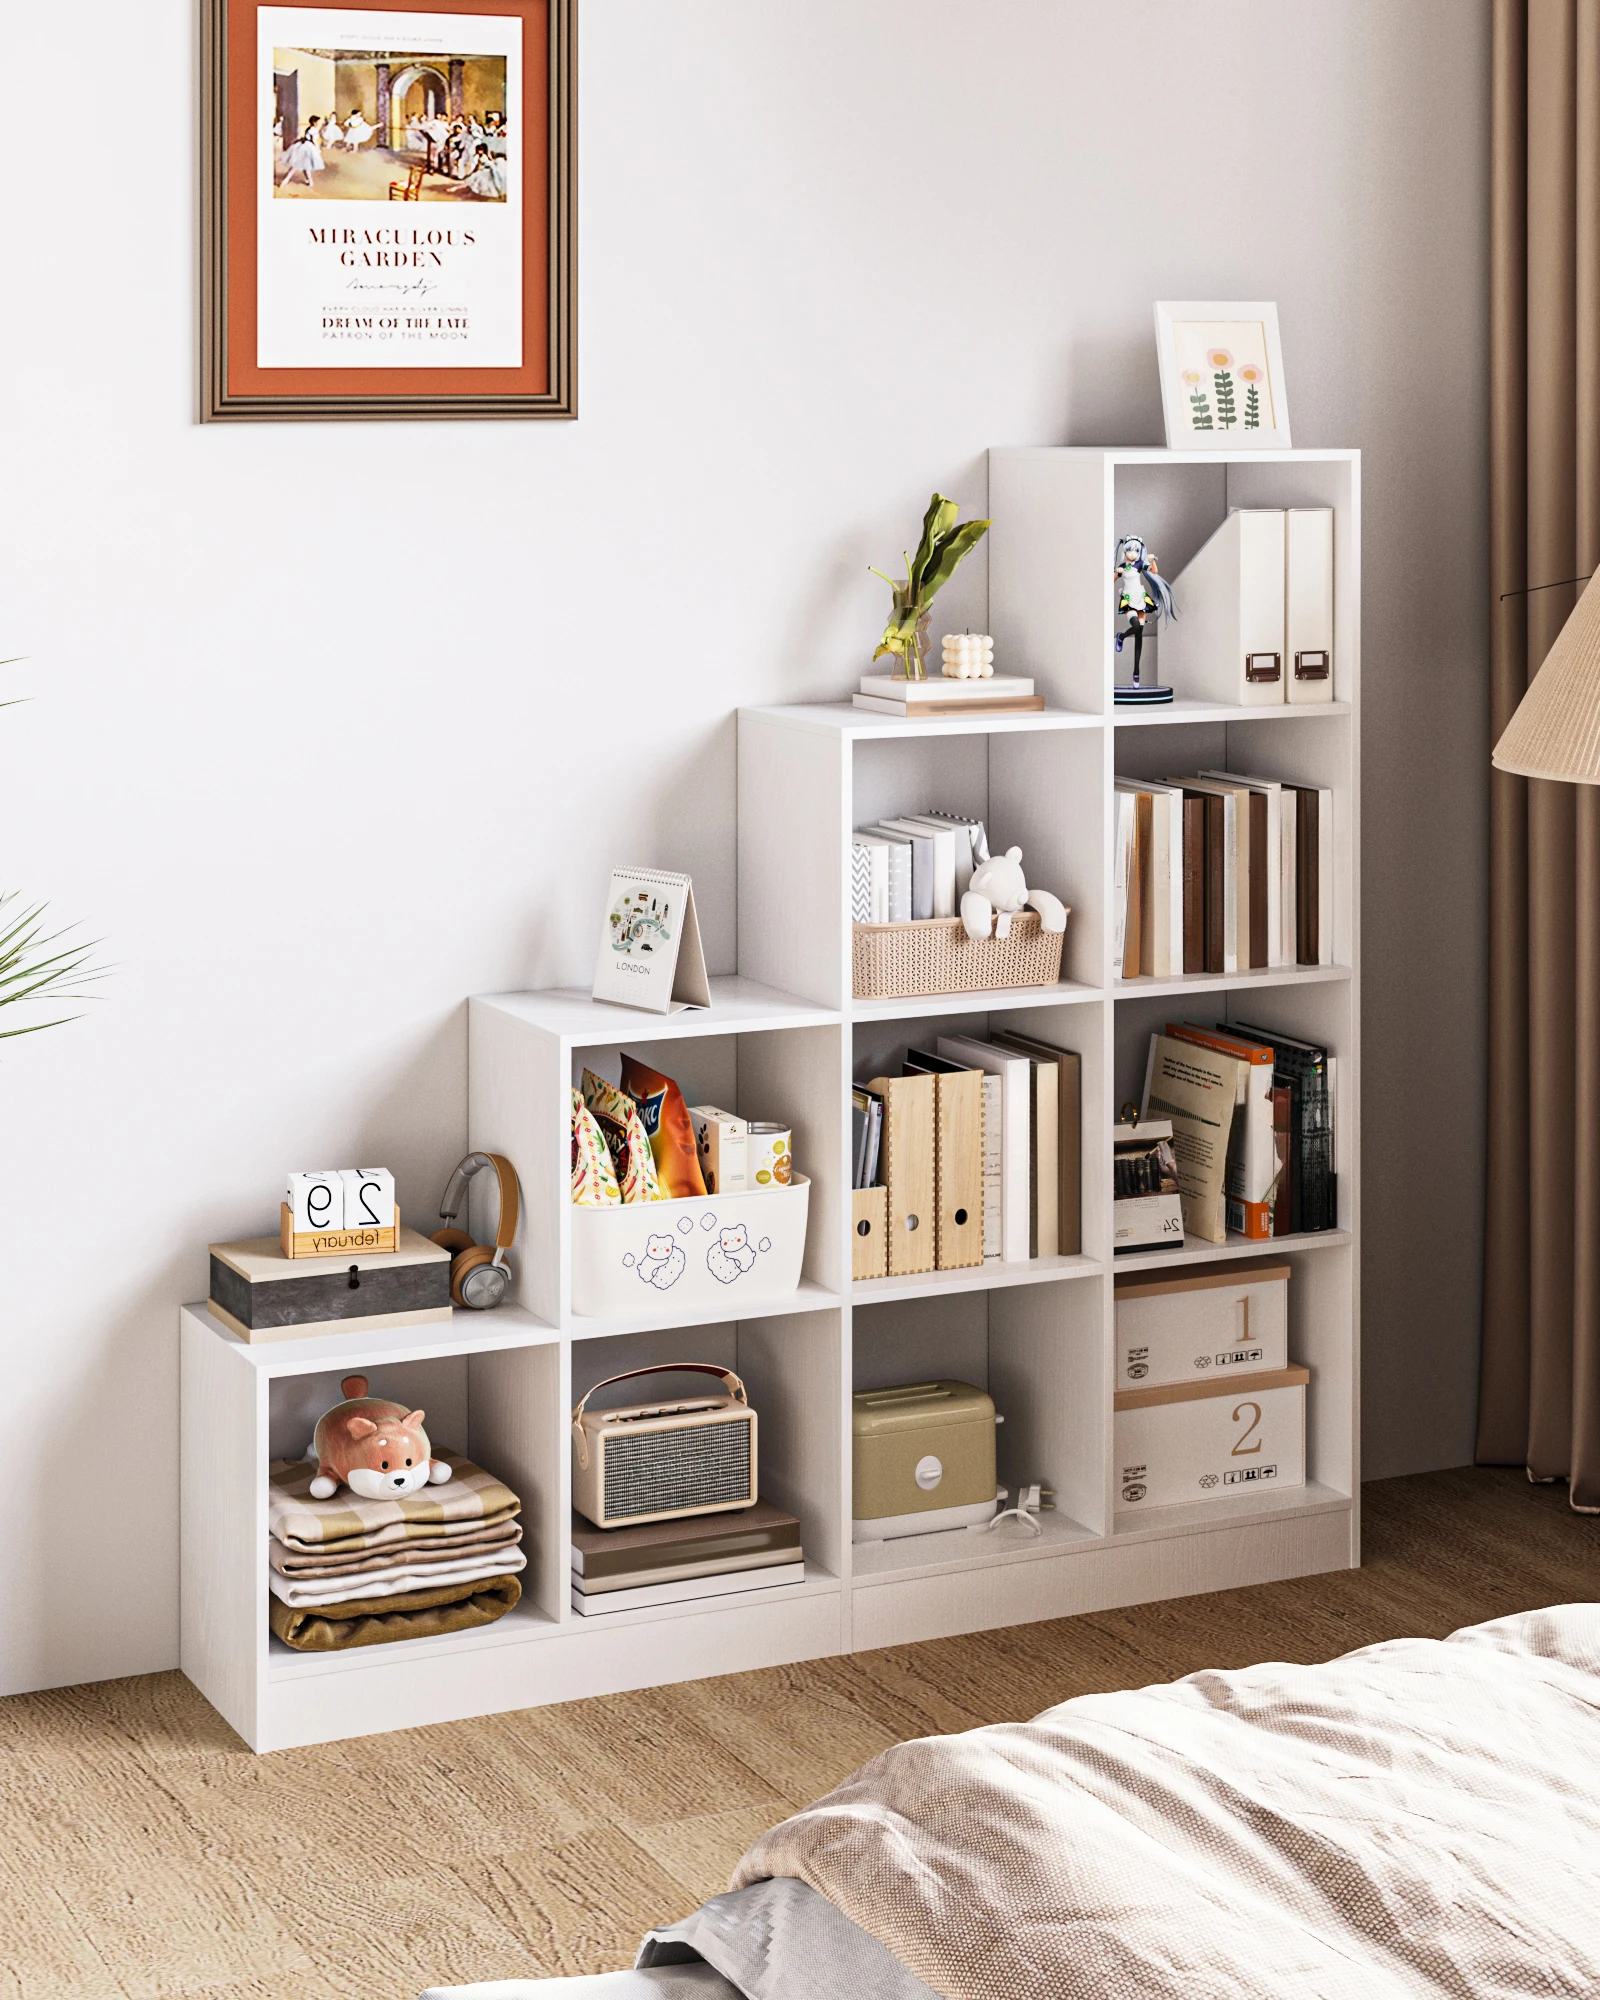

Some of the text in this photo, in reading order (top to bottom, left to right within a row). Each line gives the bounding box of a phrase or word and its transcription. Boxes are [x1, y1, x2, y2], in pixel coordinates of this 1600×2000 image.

[308, 228, 477, 246] MIRACULOUS
[340, 251, 443, 268] GARDEN
[322, 318, 470, 328] DREAM OF THE LATE
[322, 332, 468, 340] PATRON OF THE MOON
[616, 962, 650, 975] LONDON
[1236, 1295, 1256, 1343] 1
[1231, 1402, 1262, 1457] 2
